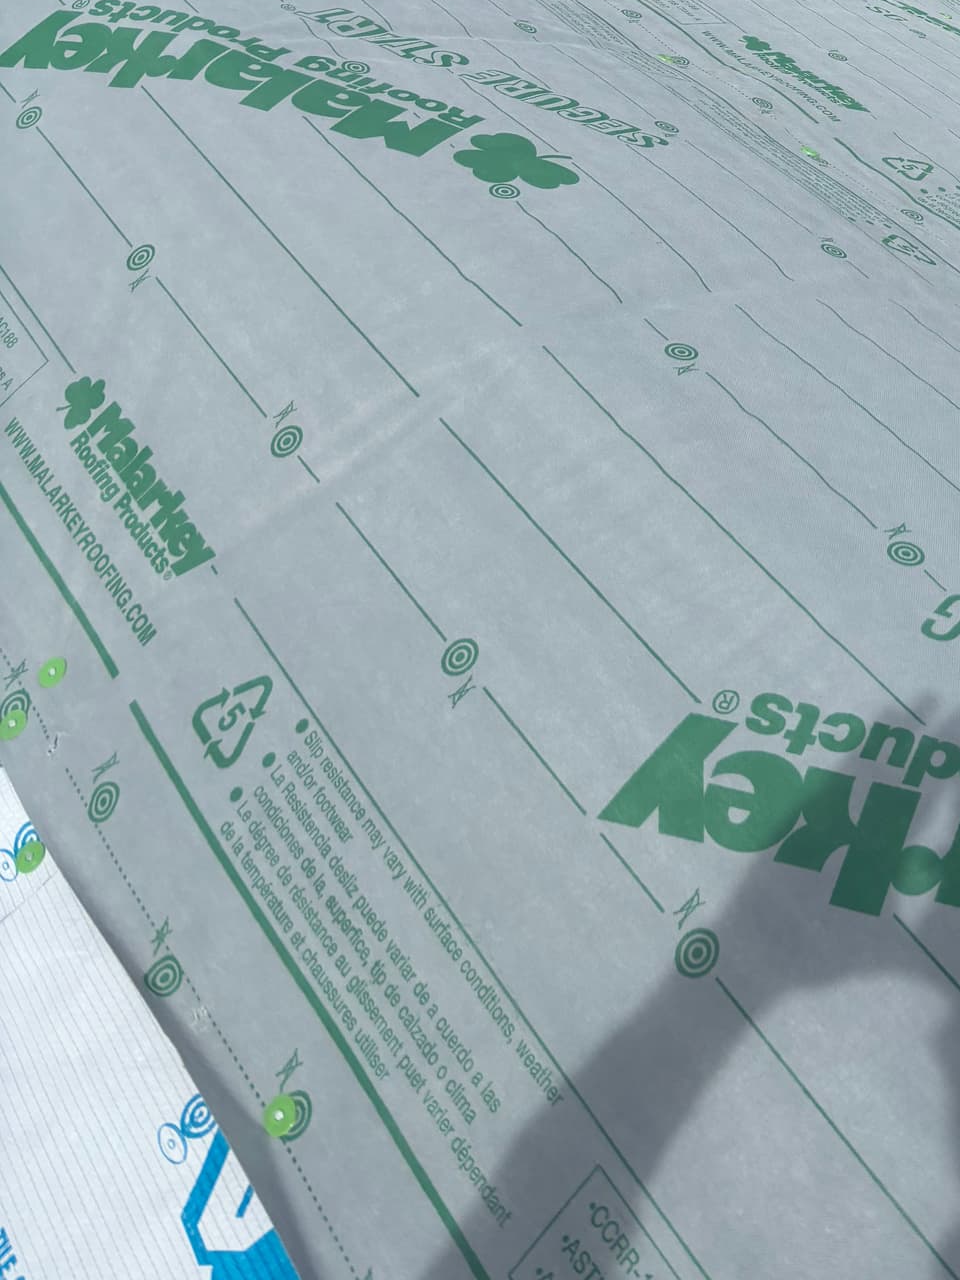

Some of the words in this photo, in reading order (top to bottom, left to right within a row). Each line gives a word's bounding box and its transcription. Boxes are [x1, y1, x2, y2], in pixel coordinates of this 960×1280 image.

[0, 10, 465, 157] Malarkey
[292, 55, 486, 130] Roofing
[458, 69, 670, 149] SECURE
[4, 417, 157, 647] WWW.MALARKEYROOFING.COM
[70, 429, 121, 504] Roofing
[87, 401, 217, 577] Malarkey
[218, 701, 246, 732] 5
[287, 750, 319, 791] and/or
[312, 785, 353, 844] footwear
[220, 820, 236, 842] de
[231, 837, 245, 857] la
[241, 851, 294, 931] température
[289, 926, 307, 949] et
[301, 946, 358, 1031] chaussures
[354, 1028, 391, 1081] utiliser
[253, 785, 305, 861] condiciones
[300, 856, 317, 880] de
[312, 872, 327, 900] la,
[369, 959, 387, 986] tip
[384, 982, 401, 1008] de
[398, 1005, 440, 1066] calzado
[436, 1065, 448, 1080] o
[445, 1079, 477, 1126] clima
[270, 764, 286, 788] La
[281, 781, 332, 859] Resistencia
[328, 854, 359, 899] desliz
[352, 895, 389, 943] puede
[385, 939, 418, 983] variar
[413, 981, 430, 1006] de
[427, 1004, 439, 1020] a
[436, 1017, 475, 1073] cuerdo
[471, 1070, 484, 1088] a
[480, 1081, 502, 1113] las
[303, 730, 324, 760] Slip
[320, 756, 366, 821] resistance
[361, 818, 387, 851] may
[383, 846, 407, 881] vary
[403, 875, 429, 910] with
[423, 907, 463, 962] surface
[460, 960, 516, 1045] conditions,
[515, 1039, 564, 1107] weather
[237, 799, 252, 823] Le
[276, 865, 293, 887] de
[289, 884, 339, 957] résistance
[335, 955, 352, 978] au
[346, 975, 403, 1057] glissement
[396, 1055, 427, 1094] puet
[422, 1090, 456, 1137] varier
[451, 1135, 513, 1228] dépendant
[591, 1205, 654, 1280] CCRR-
